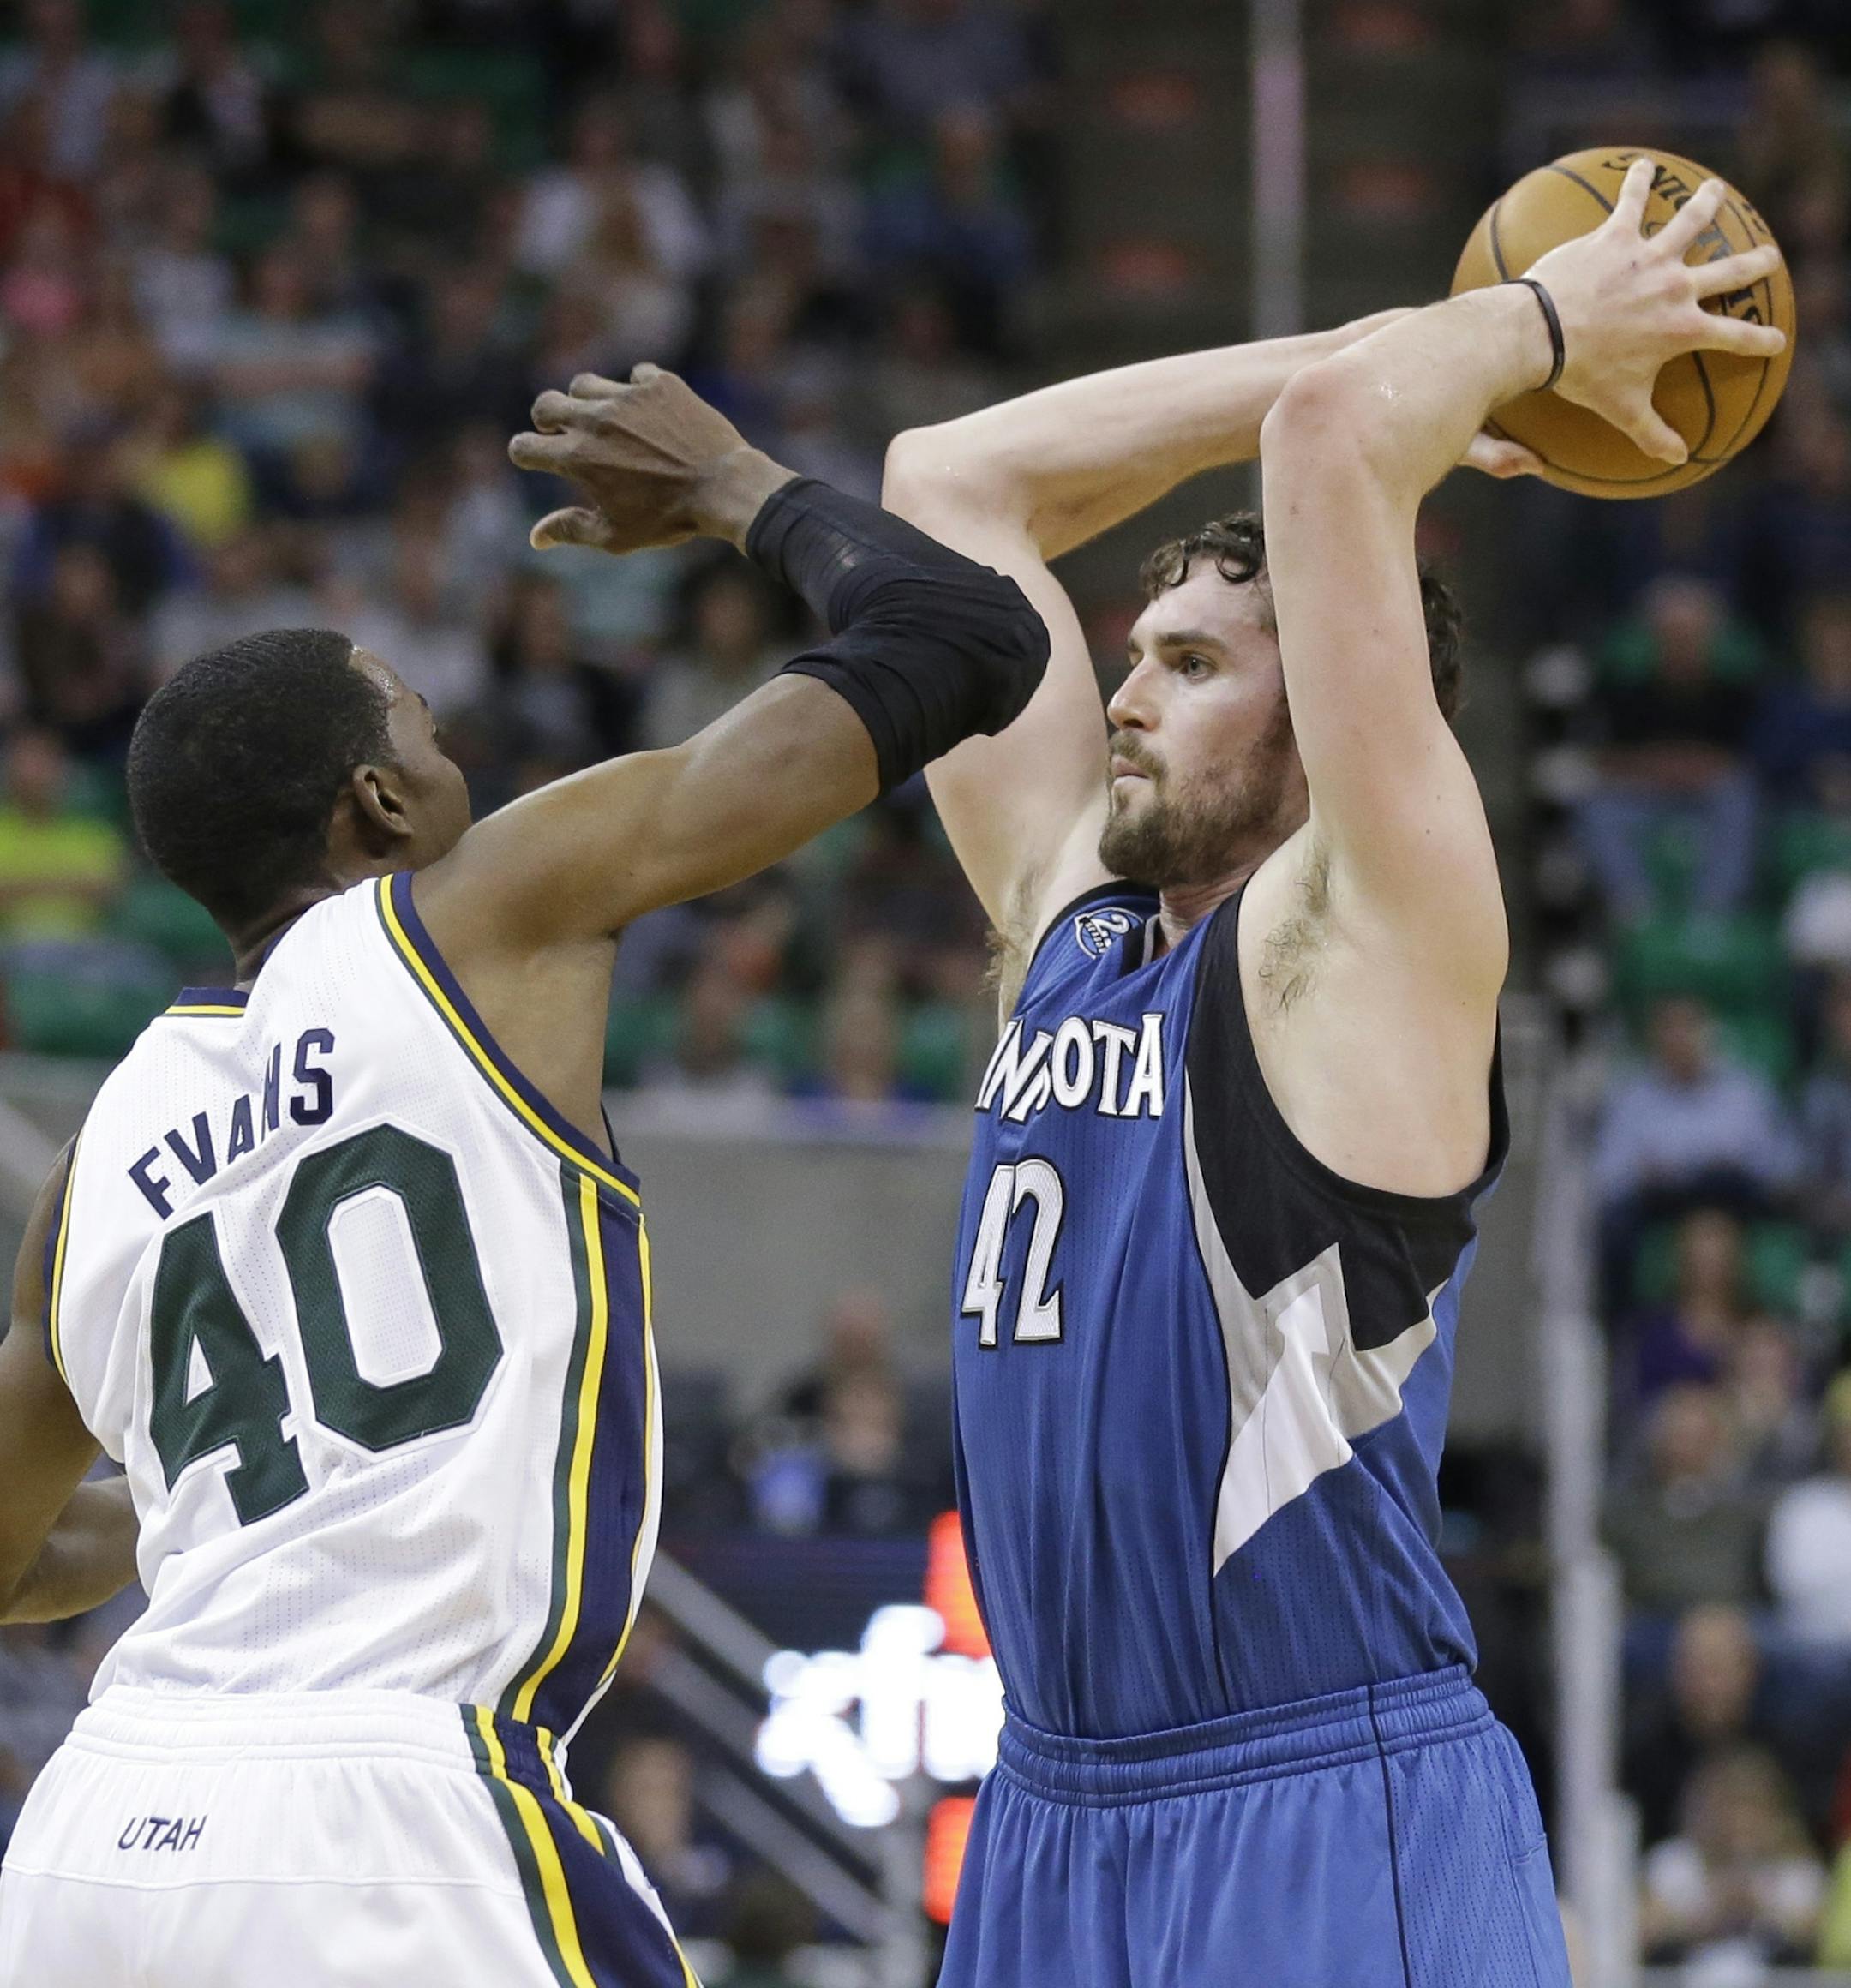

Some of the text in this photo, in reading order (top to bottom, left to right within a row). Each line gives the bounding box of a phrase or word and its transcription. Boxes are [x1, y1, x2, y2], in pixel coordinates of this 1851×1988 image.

[149, 1122, 505, 1528] 40
[961, 1158, 1064, 1348] 42
[117, 1814, 208, 1851] UTAH
